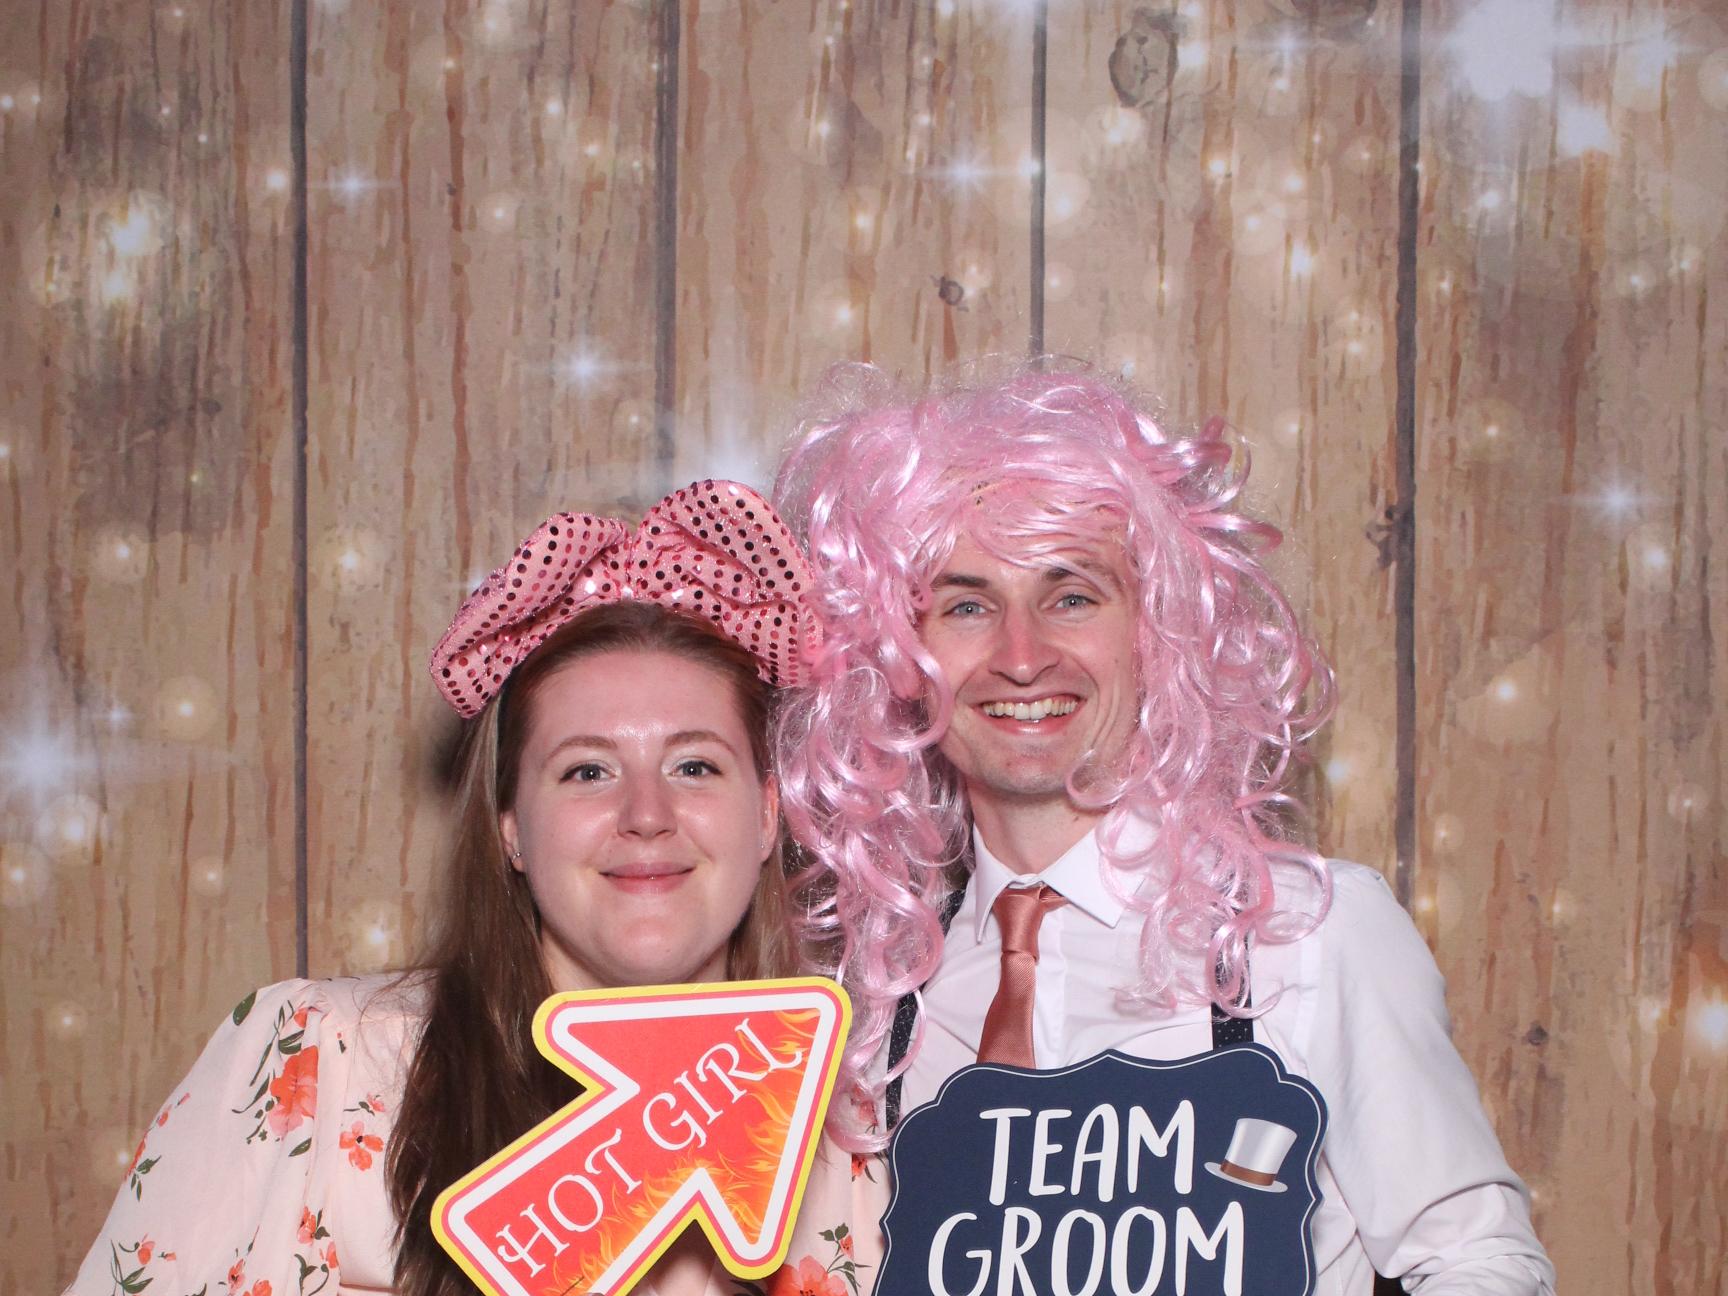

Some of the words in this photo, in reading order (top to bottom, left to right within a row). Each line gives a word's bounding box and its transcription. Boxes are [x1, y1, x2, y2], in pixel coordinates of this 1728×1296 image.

[497, 1128, 642, 1279] HOT
[642, 1018, 803, 1151] GIRL
[979, 1099, 1195, 1206] TEAM
